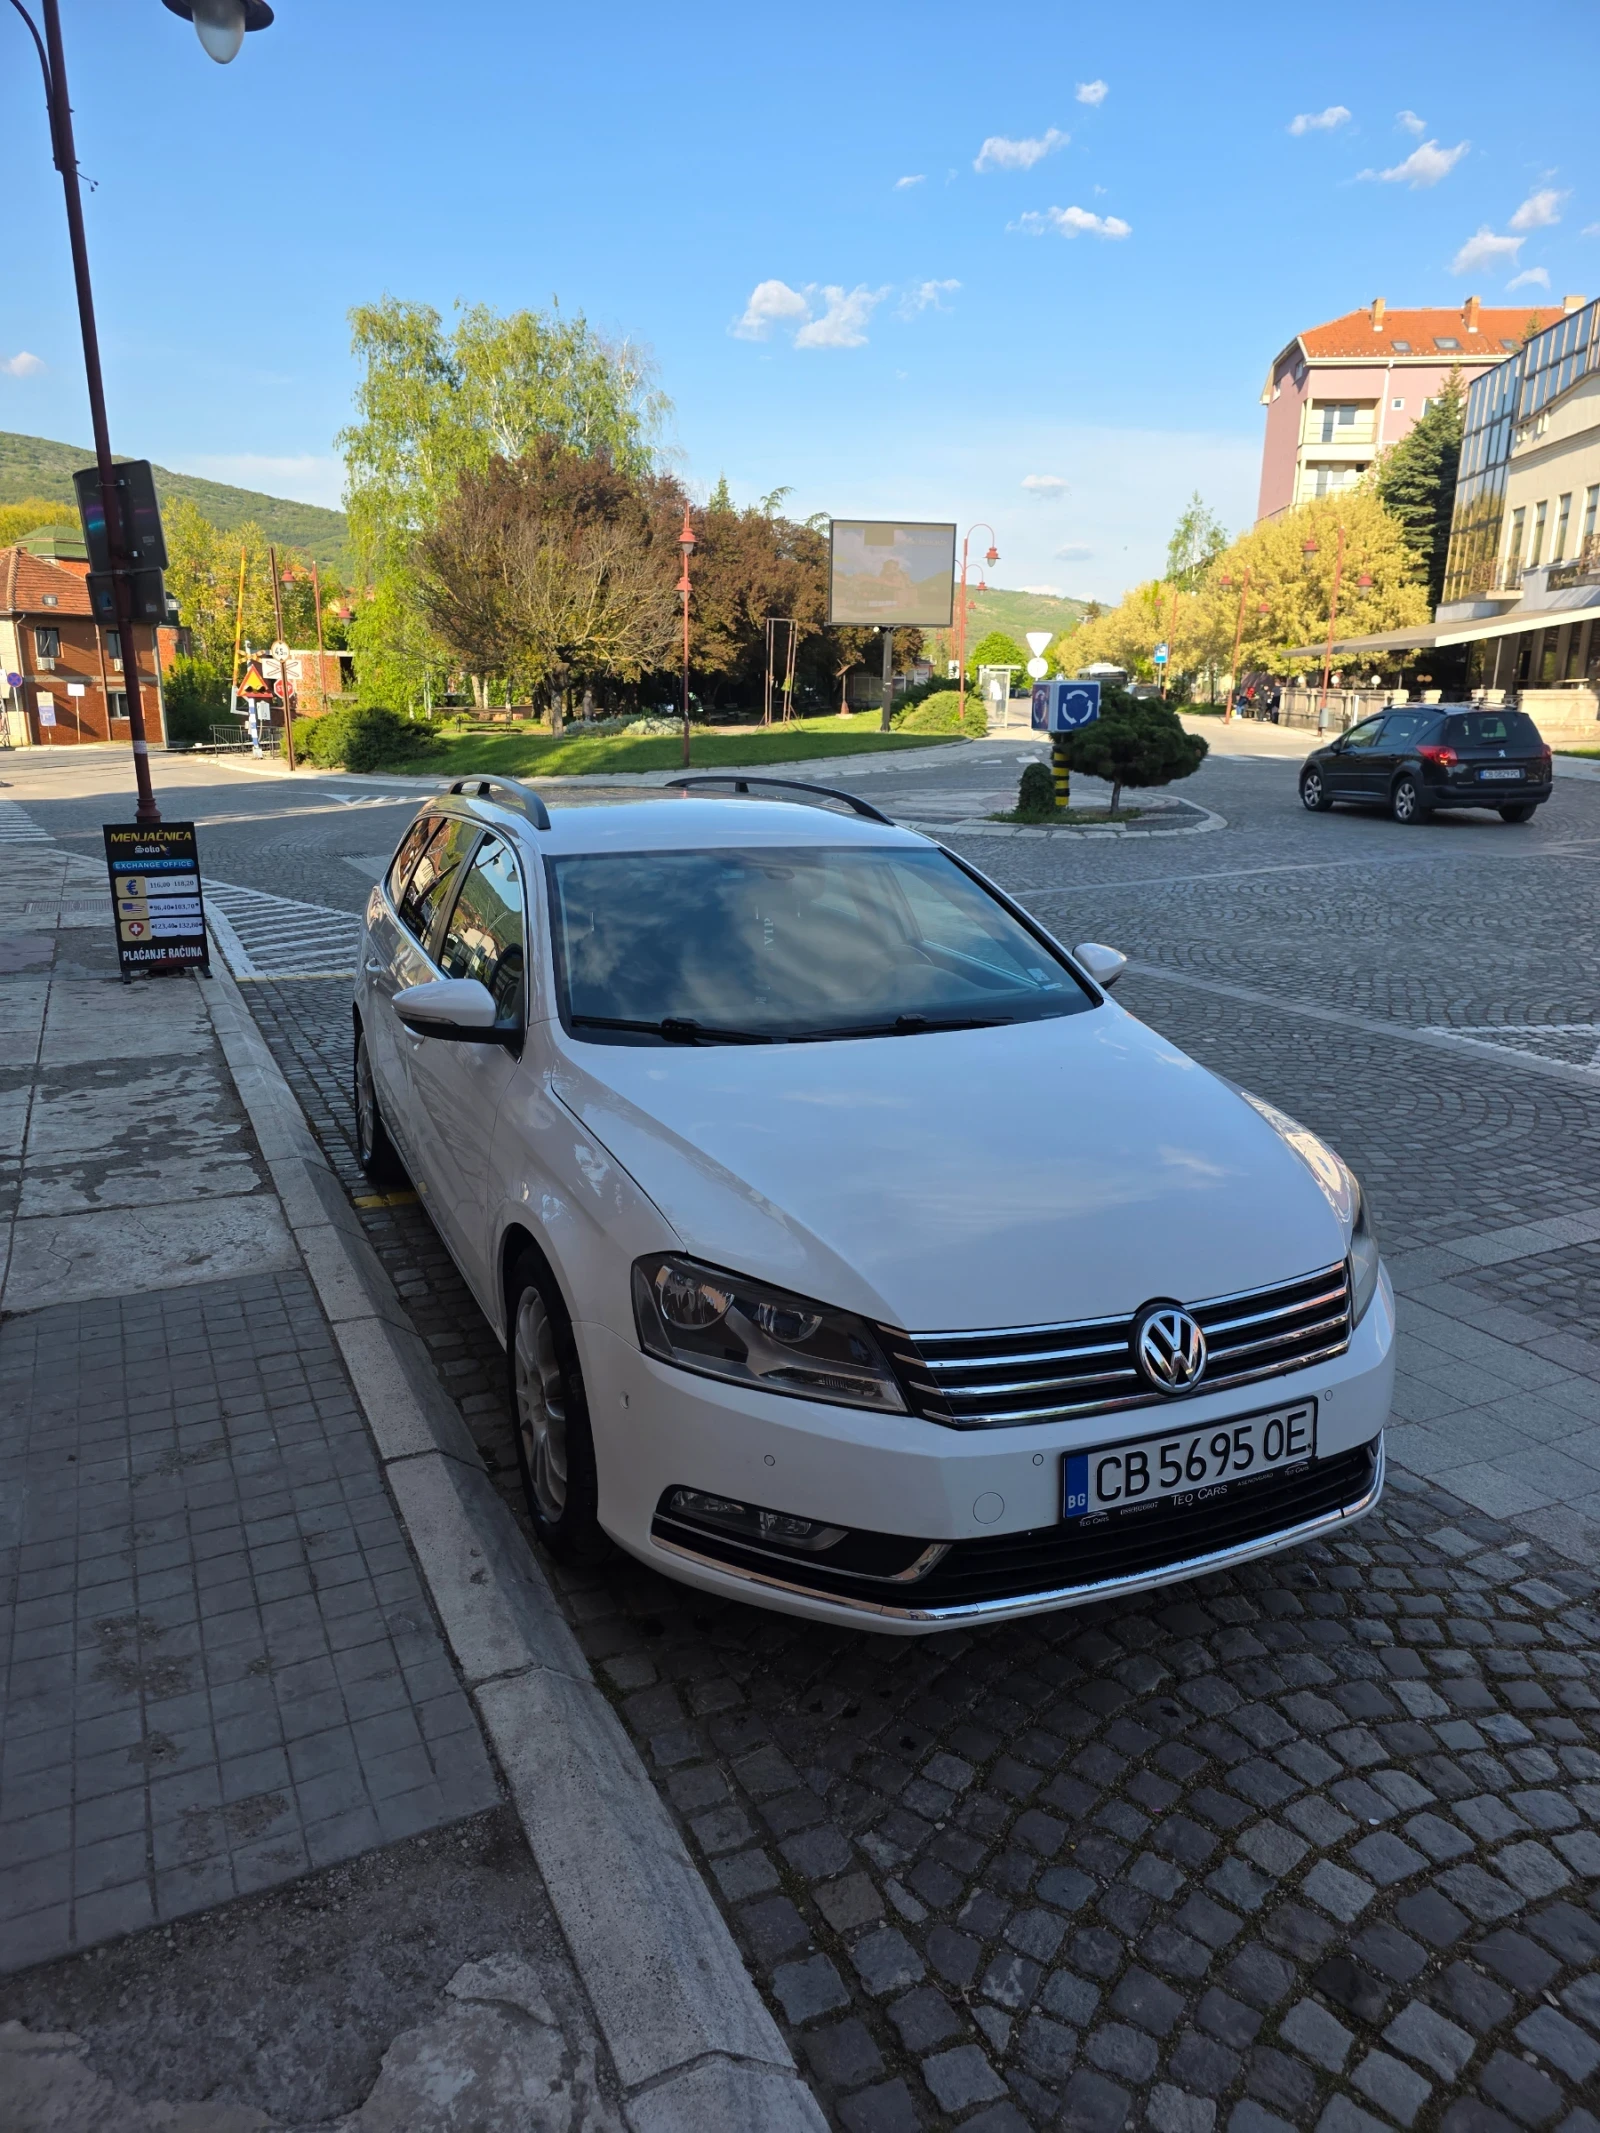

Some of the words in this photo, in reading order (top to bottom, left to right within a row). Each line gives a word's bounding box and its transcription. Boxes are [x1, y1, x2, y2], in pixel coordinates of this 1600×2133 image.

[111, 830, 192, 842] MENJAČNICA
[115, 861, 160, 869] EXCHANGE
[123, 947, 167, 961] PLAĆANJE
[168, 945, 203, 958] RAČUNA
[1160, 1425, 1254, 1488] 5695
[1197, 1485, 1228, 1500] CARS
[1067, 1493, 1086, 1509] BG
